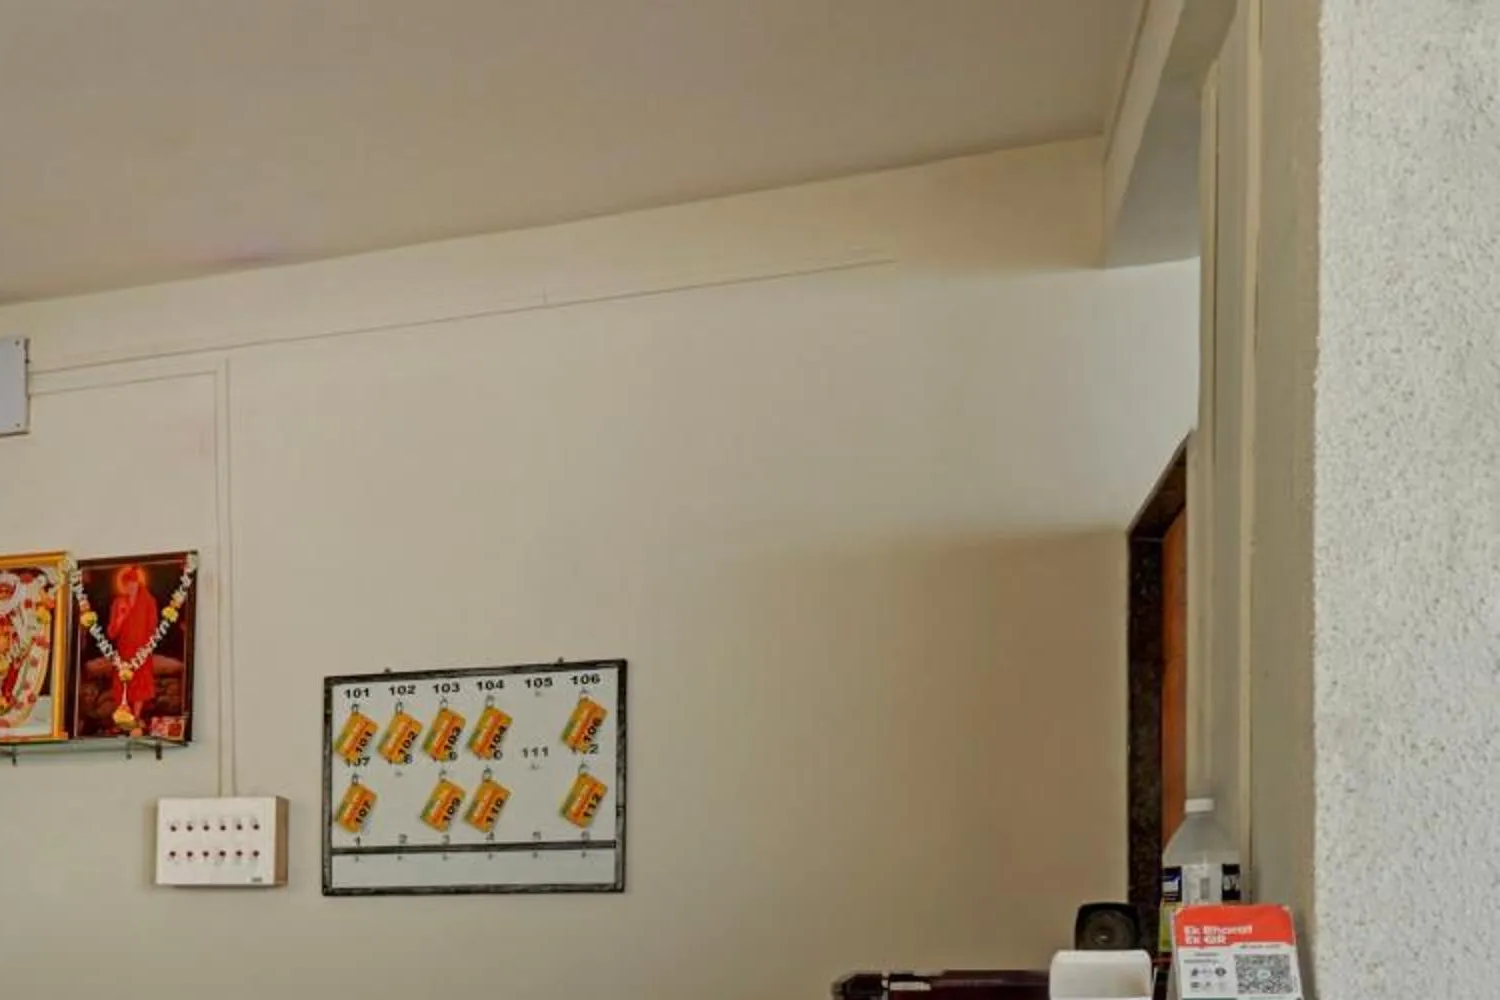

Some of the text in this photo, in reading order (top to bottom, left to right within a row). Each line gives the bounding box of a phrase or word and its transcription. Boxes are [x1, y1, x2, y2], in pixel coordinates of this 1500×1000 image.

[344, 673, 601, 699] 101 102 103 104 105 106
[522, 746, 549, 759] 111
